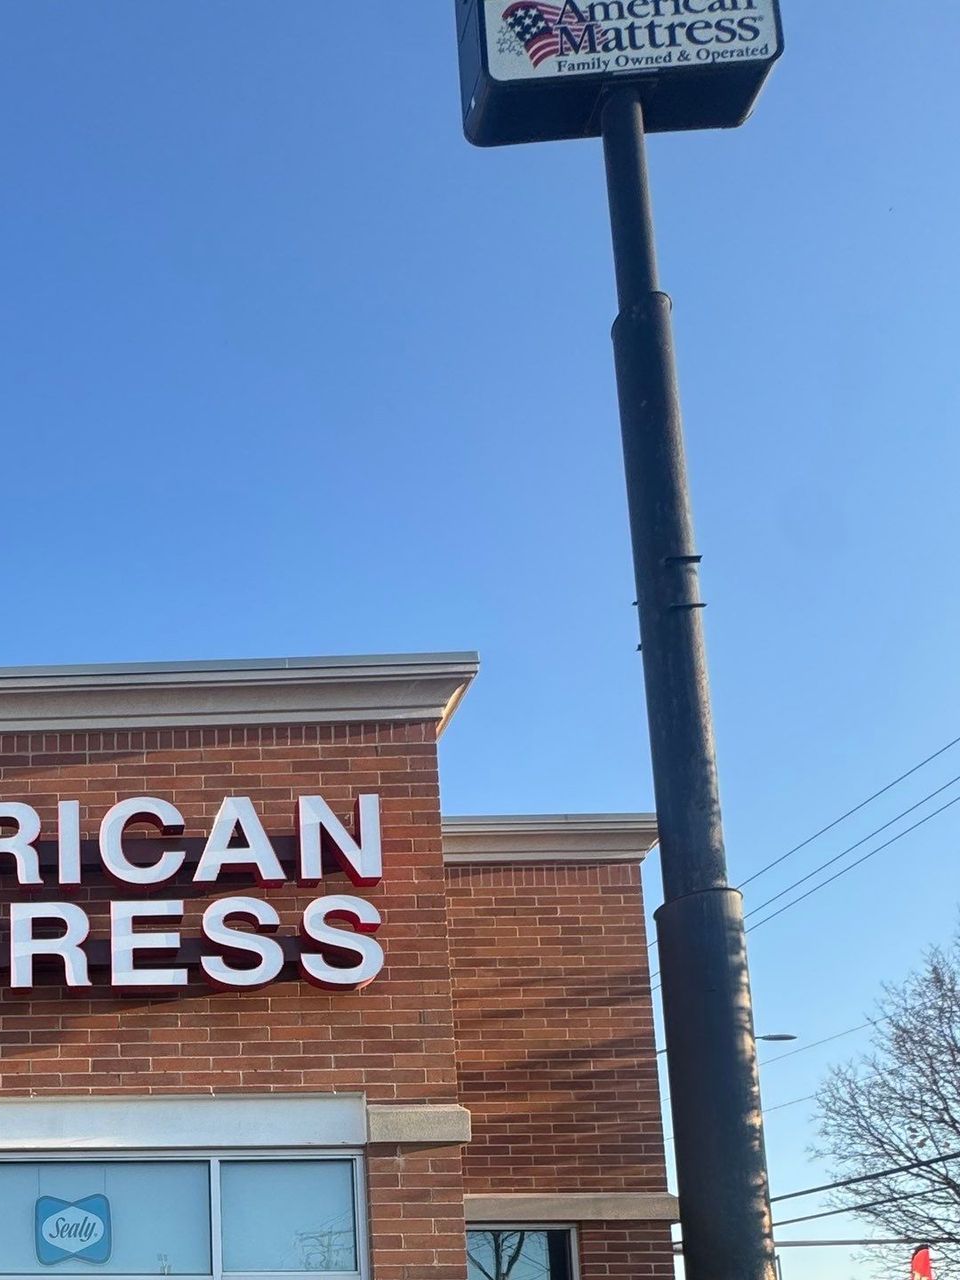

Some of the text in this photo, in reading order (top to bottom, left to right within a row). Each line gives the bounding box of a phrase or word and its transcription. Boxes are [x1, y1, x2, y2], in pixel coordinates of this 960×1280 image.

[553, 16, 760, 57] Mattress
[556, 43, 769, 73] Family Owned & Operated
[49, 1216, 96, 1242] Sealy
